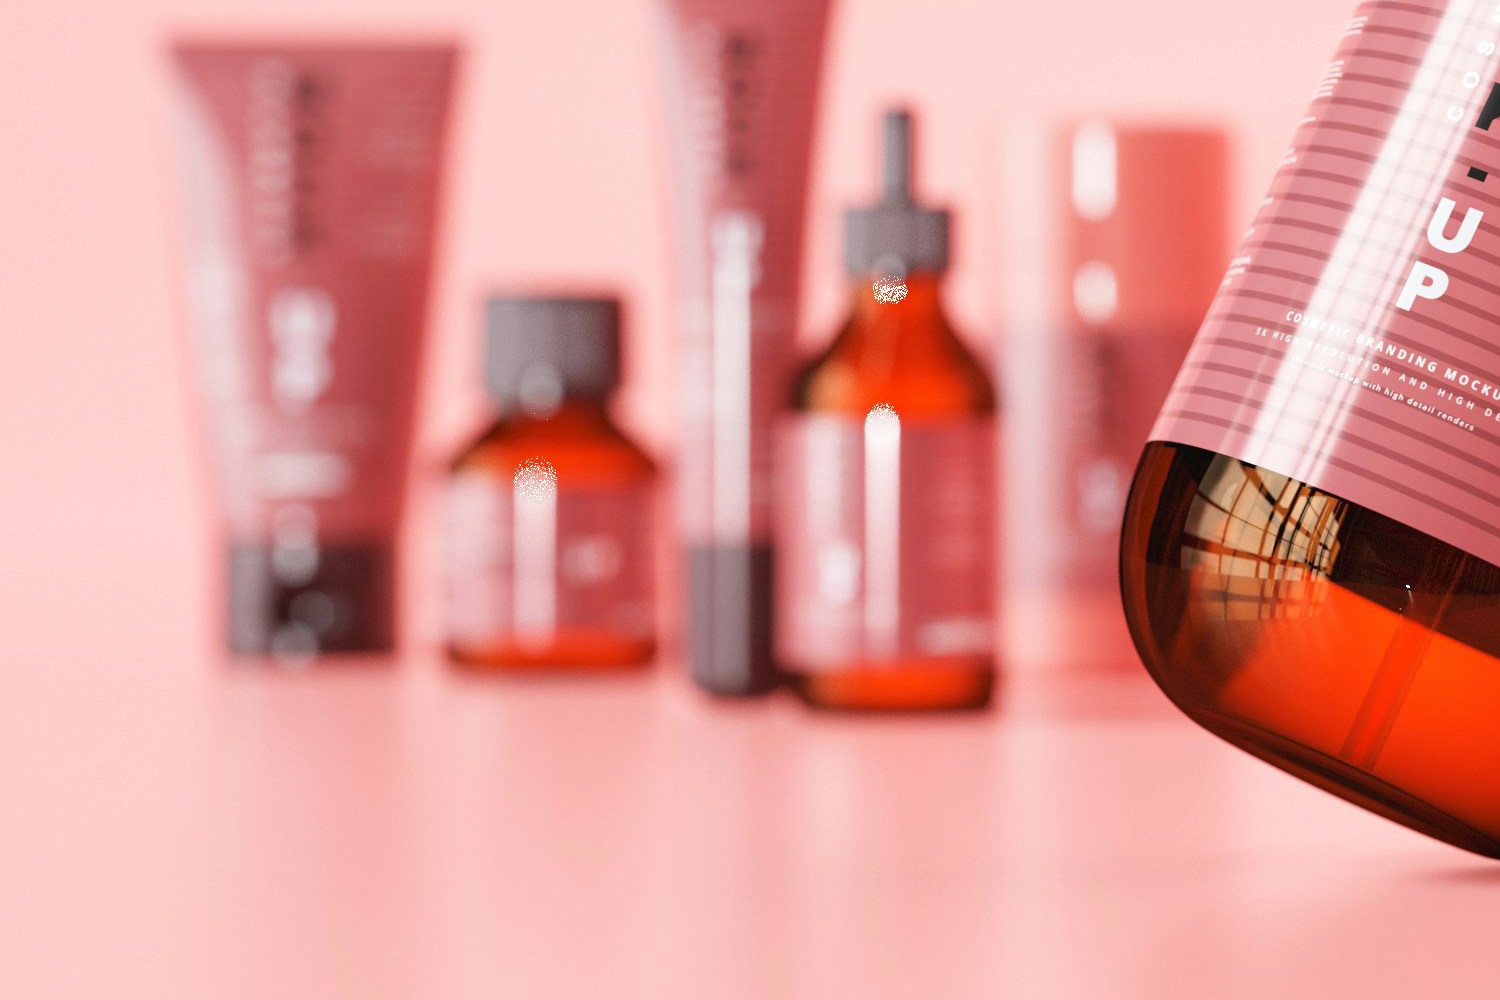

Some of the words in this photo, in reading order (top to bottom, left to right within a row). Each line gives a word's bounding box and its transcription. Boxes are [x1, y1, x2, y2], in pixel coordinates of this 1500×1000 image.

[1255, 327, 1268, 337] 5K
[1272, 331, 1300, 345] HIGH
[1306, 340, 1391, 376] RESOLUTION
[1398, 373, 1428, 390] AND
[1437, 388, 1475, 410] HIGH
[1286, 310, 1351, 340] COSMETIC
[1355, 333, 1438, 373] BRANDING
[1327, 367, 1360, 385] mockup
[1362, 379, 1382, 392] with
[1383, 386, 1404, 402] high
[1406, 396, 1435, 414] detail
[1437, 409, 1475, 431] renders
